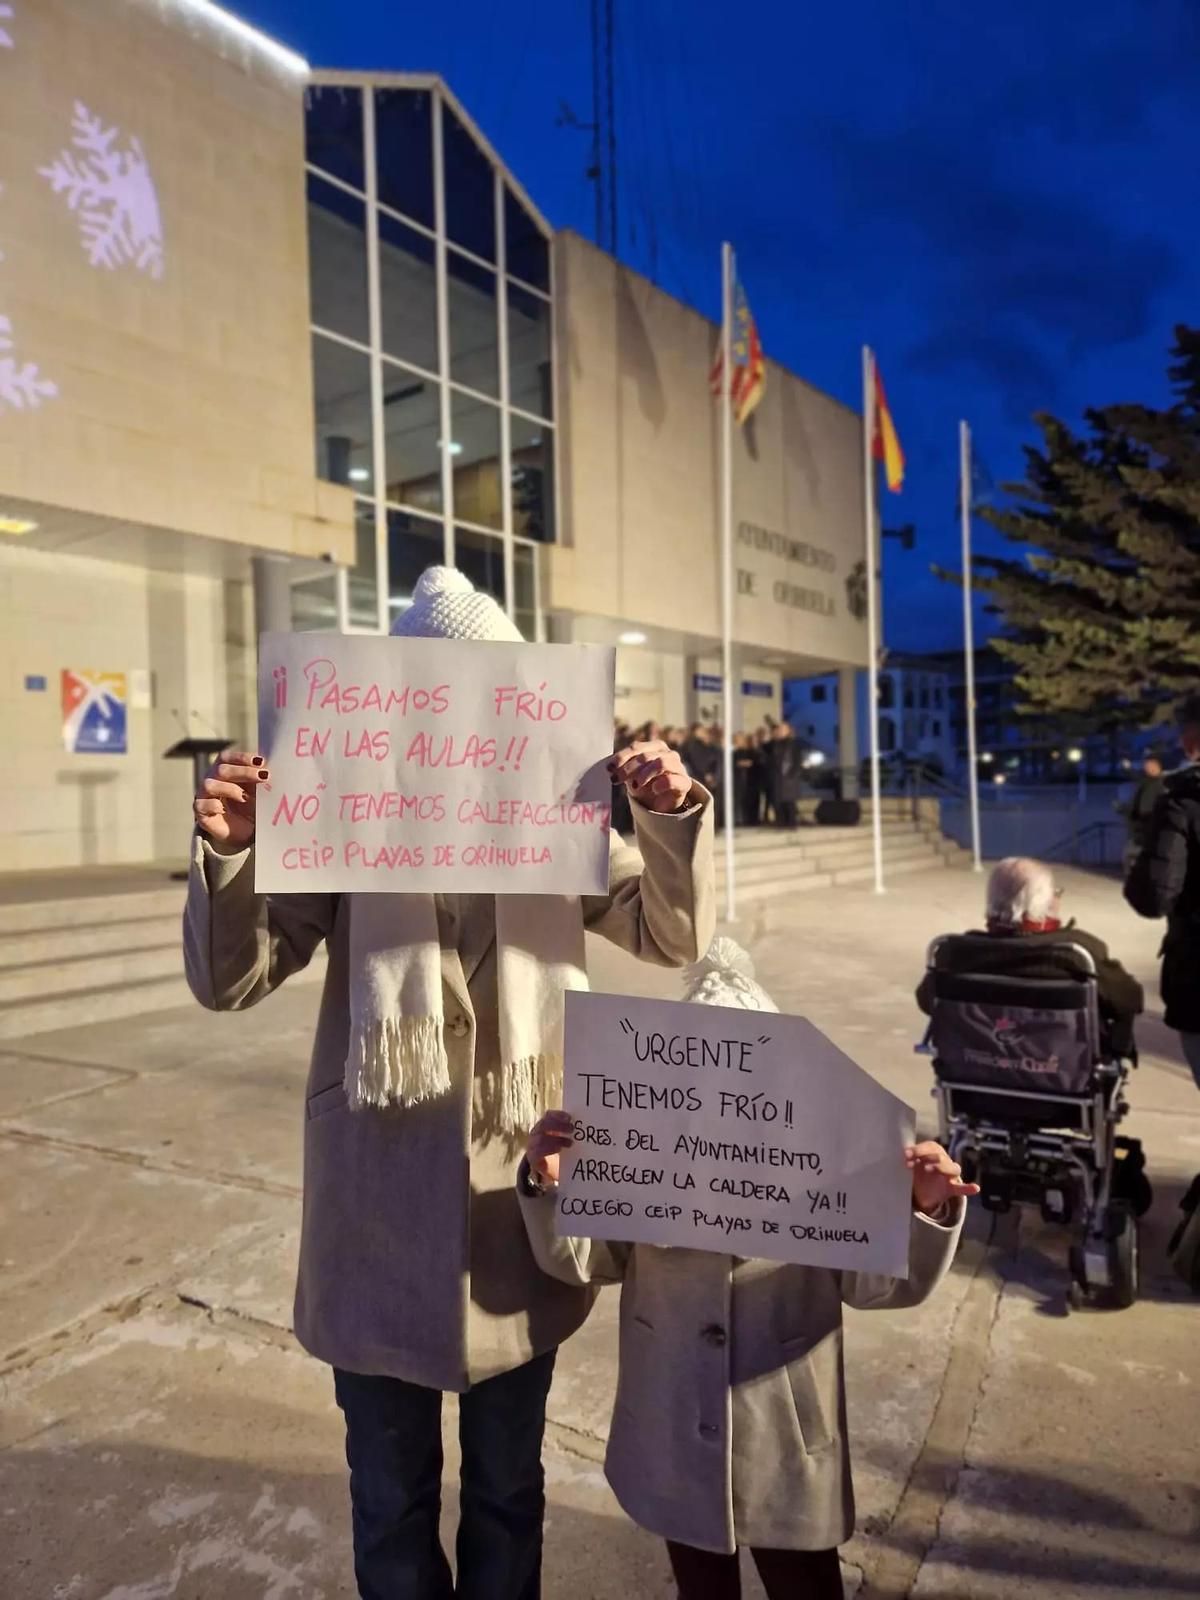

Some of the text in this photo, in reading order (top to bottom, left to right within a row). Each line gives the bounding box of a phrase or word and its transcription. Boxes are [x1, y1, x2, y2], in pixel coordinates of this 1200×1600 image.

[494, 682, 568, 722] FRÍO
[295, 728, 332, 758] EN
[344, 729, 389, 761] LAS
[339, 792, 447, 822] TENEMOS
[344, 841, 425, 870] PLAYAS
[432, 845, 456, 867] DE
[461, 839, 552, 867] ORIHUELA
[577, 1073, 703, 1112] TENEMOS
[573, 1120, 823, 1176] SRES. DEL AYUNTAMIENTO,
[571, 1158, 664, 1185] ARREGLEN
[673, 1172, 696, 1190] LA
[709, 1178, 791, 1204] CALDERA
[560, 1197, 634, 1217] COLEGIO
[692, 1209, 752, 1236] PLAYAS
[762, 1220, 780, 1234] DE
[789, 1226, 870, 1245] ORIHUELA
